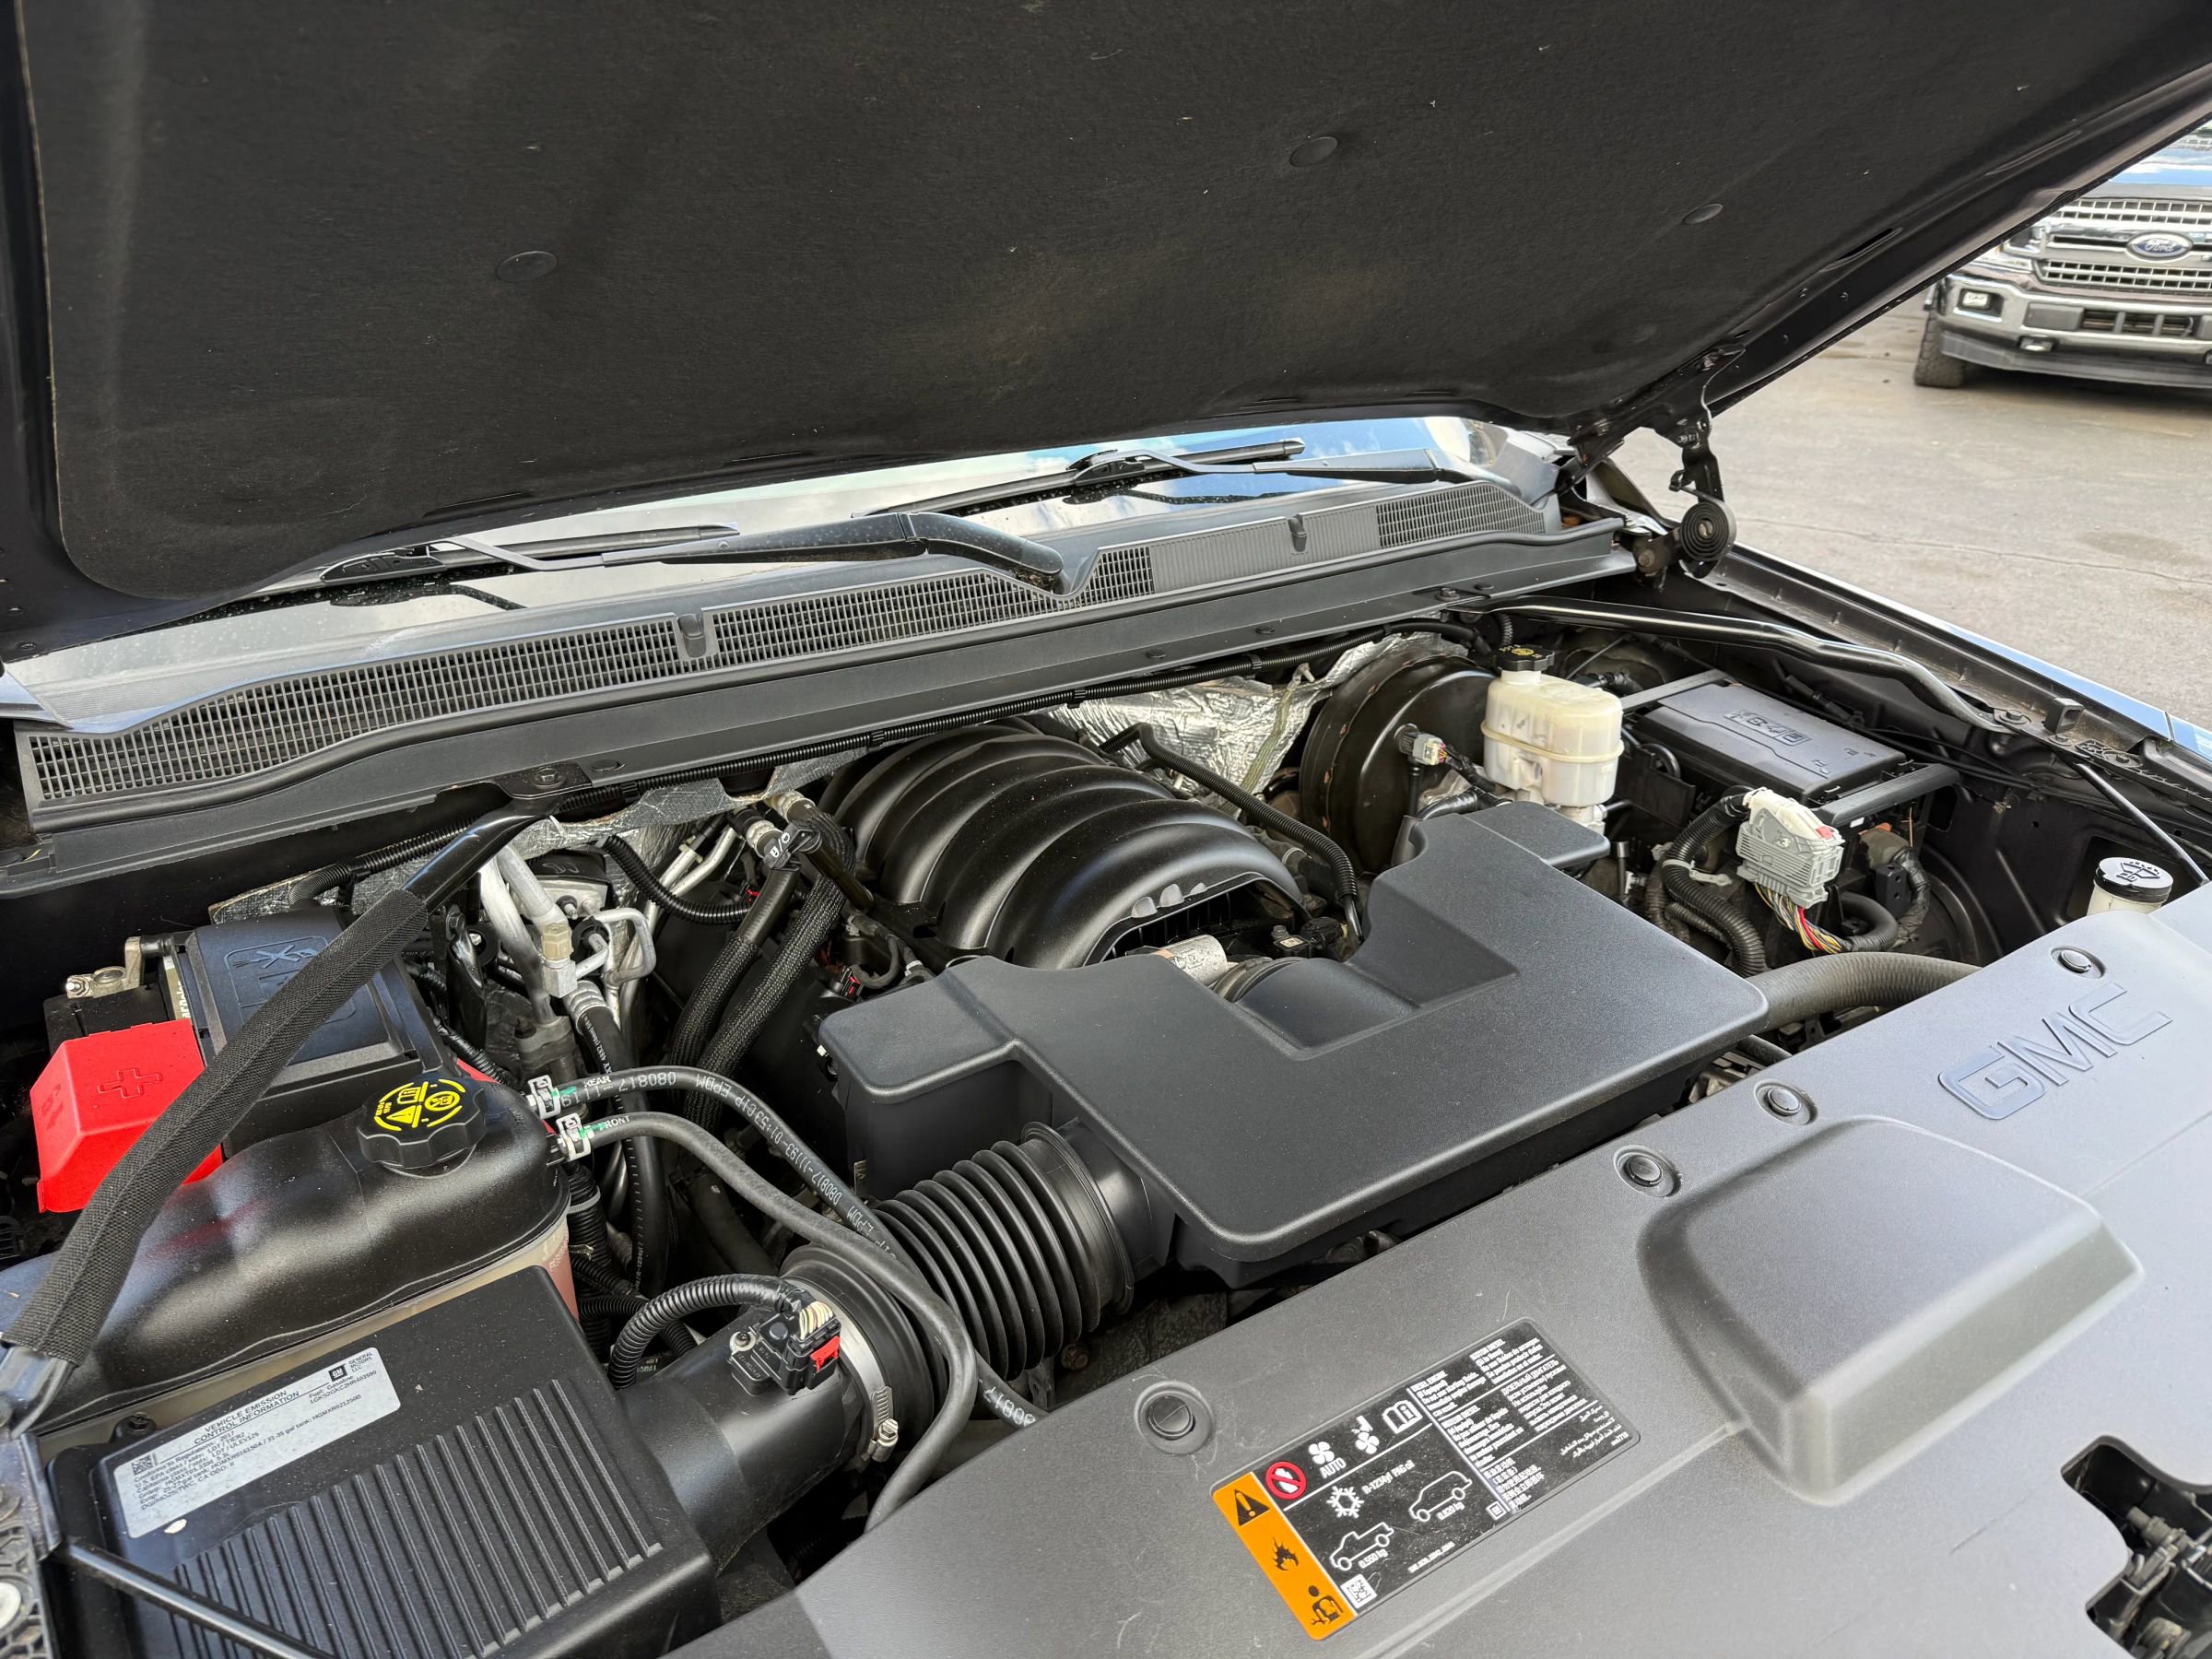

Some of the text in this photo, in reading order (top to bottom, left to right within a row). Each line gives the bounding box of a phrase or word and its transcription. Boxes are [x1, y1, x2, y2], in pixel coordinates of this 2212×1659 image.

[2144, 238, 2175, 253] Ford
[1937, 982, 2173, 1121] GMC
[695, 1073, 733, 1099] EPDM
[193, 1389, 300, 1445] CONTROL INFORMATION
[204, 1388, 288, 1433] VEHICLE EMISSION
[218, 1430, 235, 1441] 2017
[1316, 1455, 1349, 1479] AUTO
[1360, 1471, 1395, 1496] R-1234yf
[1390, 1463, 1408, 1477] PAG
[1357, 1551, 1380, 1569] 0.550
